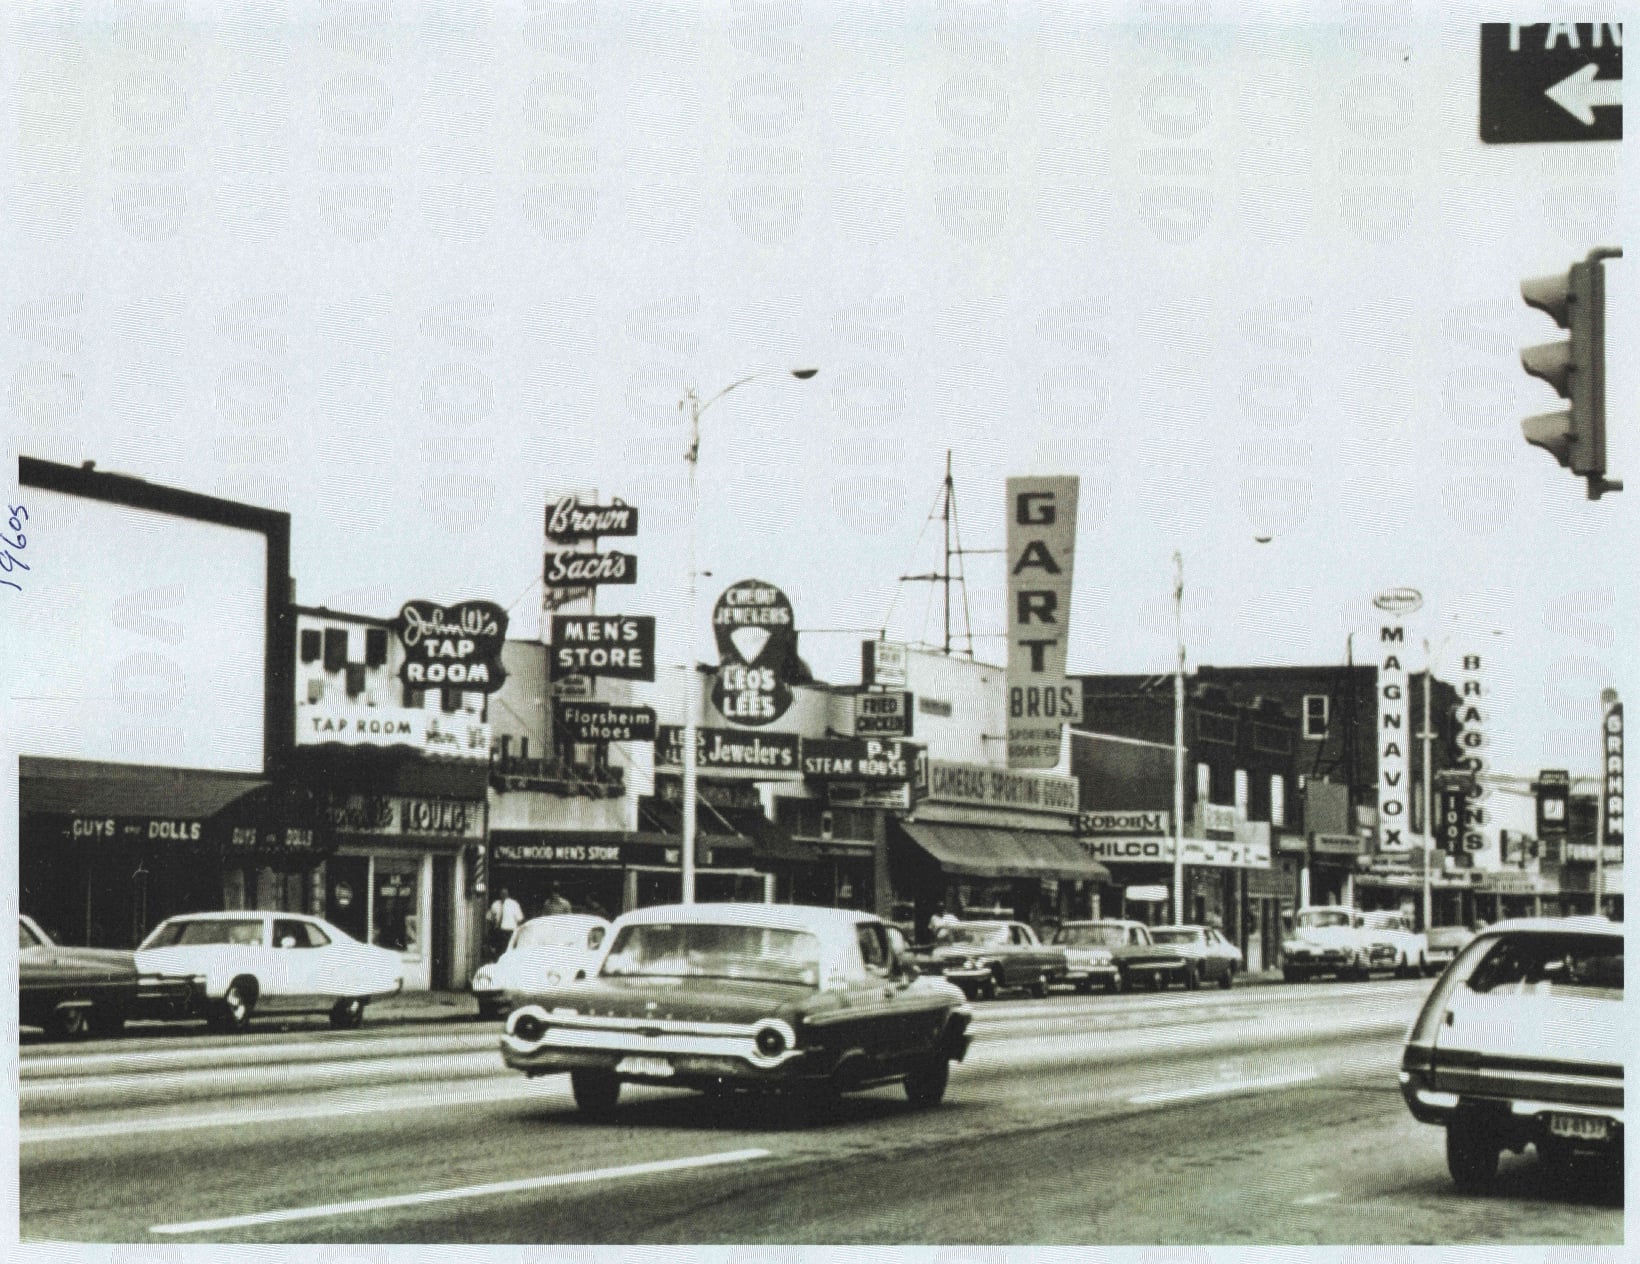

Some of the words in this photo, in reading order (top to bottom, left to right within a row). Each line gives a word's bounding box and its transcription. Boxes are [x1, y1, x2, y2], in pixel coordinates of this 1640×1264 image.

[548, 496, 629, 533] Brown
[548, 550, 626, 580] Sach's
[1013, 491, 1061, 673] GART
[565, 620, 638, 641] MEN'S
[424, 639, 475, 658] TAP
[559, 648, 643, 667] STORE
[407, 663, 489, 682] ROOM
[1010, 686, 1078, 718] BROS.
[312, 717, 348, 732] TAP
[356, 719, 412, 734] ROOM
[565, 708, 649, 724] Florsheim
[581, 724, 631, 738] shoes
[1379, 626, 1405, 845] MAGNAVOX
[709, 735, 792, 765] Jewelers
[805, 758, 852, 774] STEAK
[859, 760, 906, 775] HOUSE
[73, 819, 115, 836] GUYS
[149, 821, 201, 840] DOLLS
